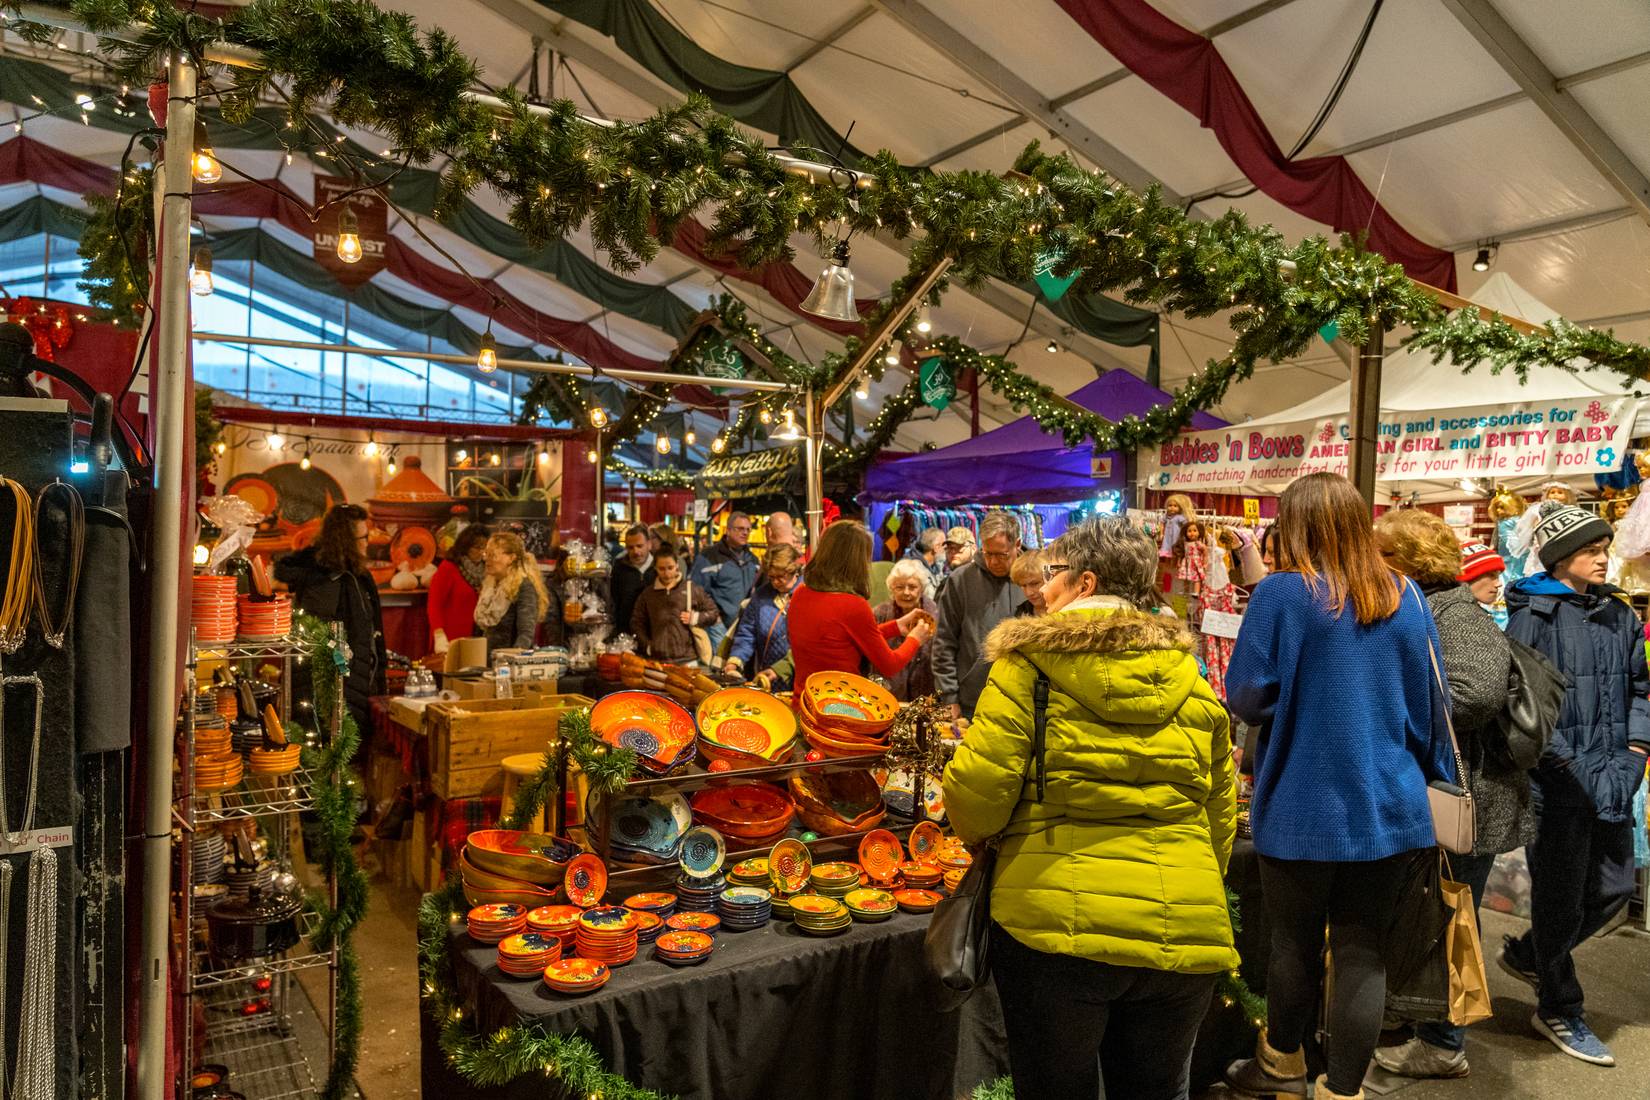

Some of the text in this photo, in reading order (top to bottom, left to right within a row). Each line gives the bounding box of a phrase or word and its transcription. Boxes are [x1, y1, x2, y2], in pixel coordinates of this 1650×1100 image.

[1339, 407, 1577, 438] Cing and accessories for
[1160, 432, 1305, 466] Babies 'n Bows
[1402, 437, 1444, 453] GIRL
[1450, 434, 1480, 450] and
[1486, 430, 1549, 448] BITTY
[1556, 425, 1618, 444] BABY
[1173, 470, 1193, 483] And
[1198, 468, 1246, 484] matching
[1250, 461, 1329, 479] handcrafted
[1394, 457, 1417, 473] for
[1424, 456, 1459, 475] your
[1465, 452, 1508, 470] little
[1515, 449, 1546, 473] girl
[1555, 447, 1590, 466] too!
[37, 832, 69, 844] Chain
